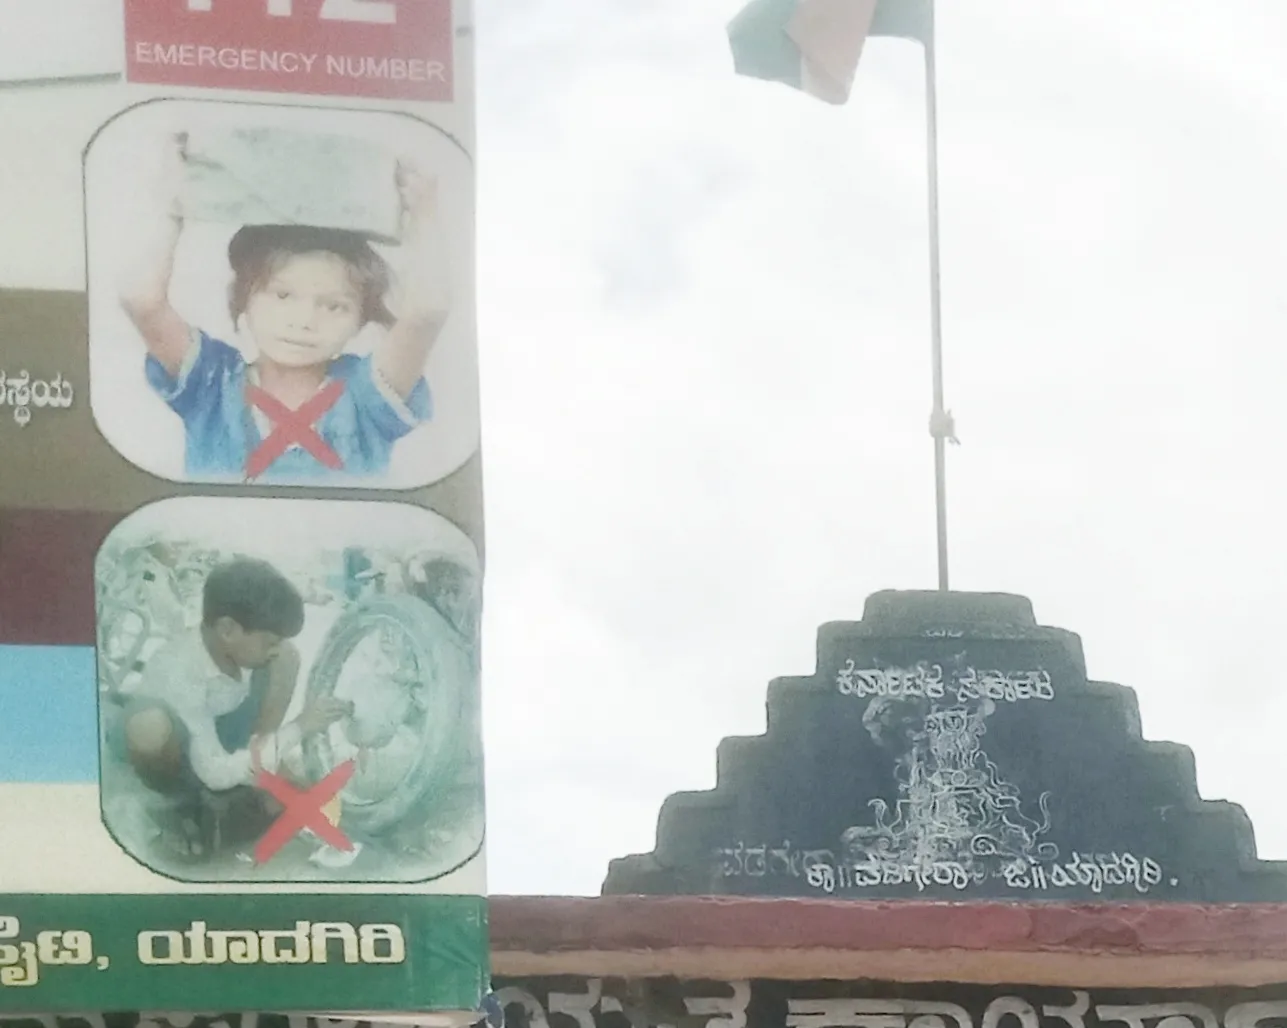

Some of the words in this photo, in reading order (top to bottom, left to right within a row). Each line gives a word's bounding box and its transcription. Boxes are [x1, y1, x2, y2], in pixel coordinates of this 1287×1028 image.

[135, 41, 318, 73] EMERGENCY
[326, 55, 446, 82] NUMBER
[137, 920, 406, 965] ಯಾದಗಿರಿ
